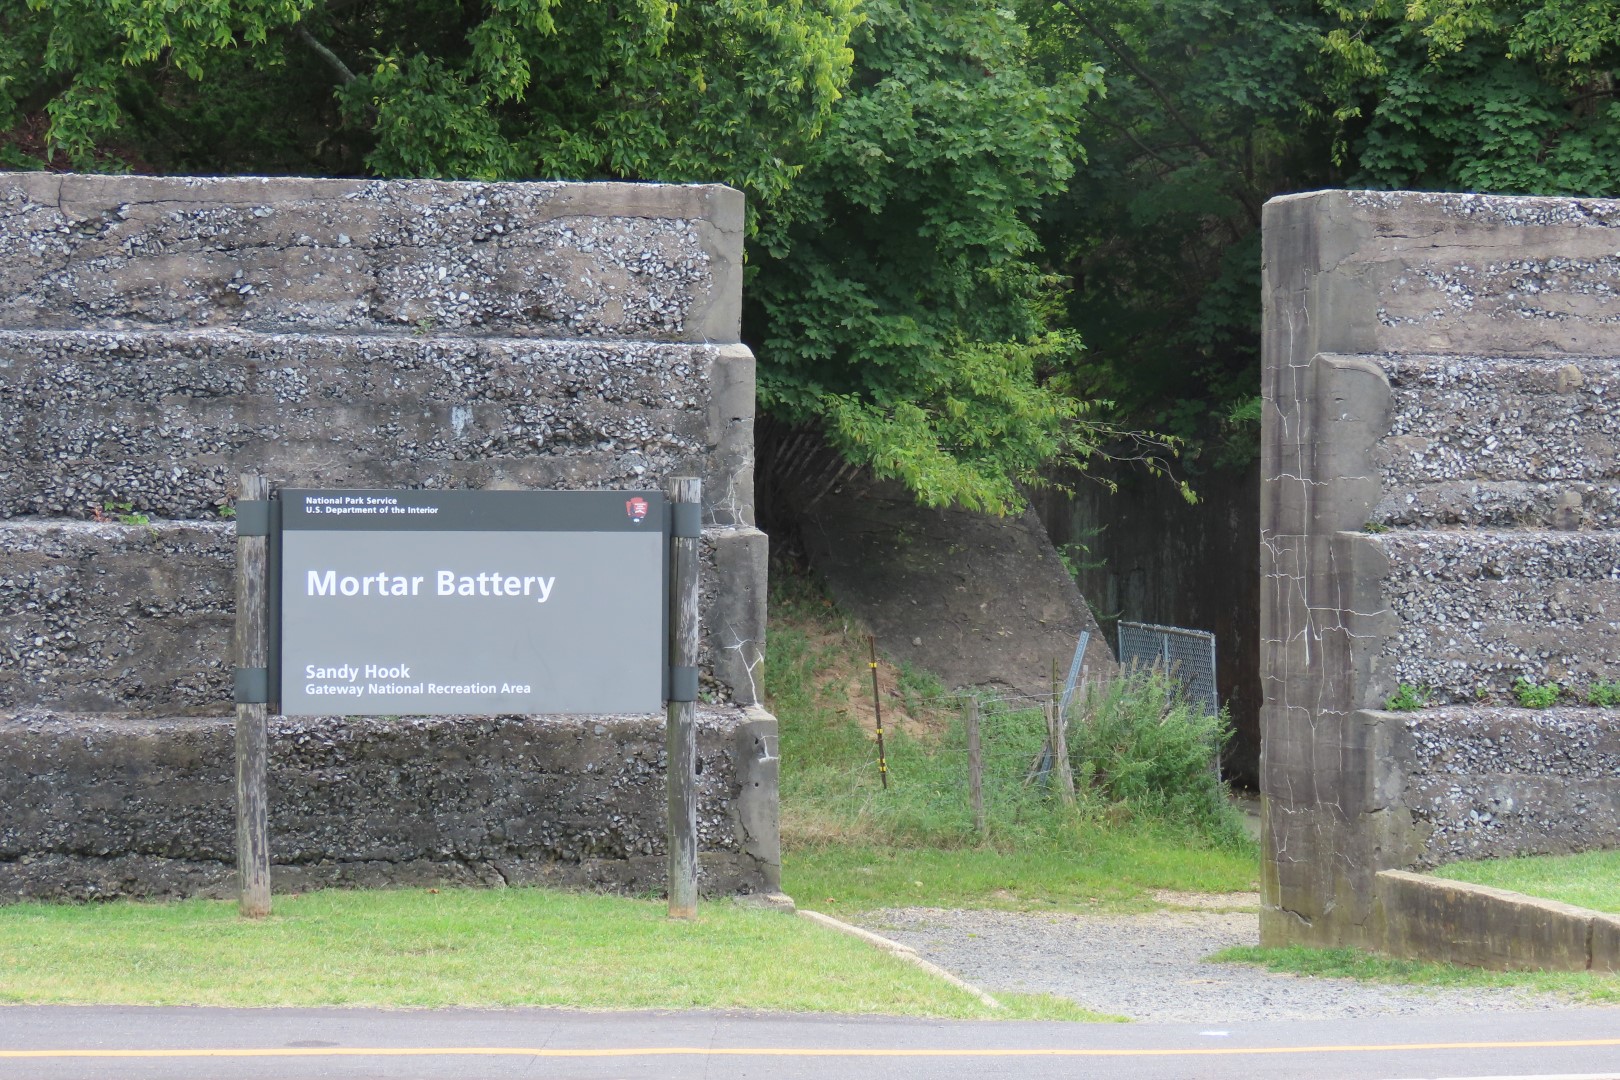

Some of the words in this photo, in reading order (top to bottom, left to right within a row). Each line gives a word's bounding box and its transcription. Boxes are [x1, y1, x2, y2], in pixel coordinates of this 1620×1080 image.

[306, 496, 342, 505] National
[345, 496, 364, 505] Park
[366, 496, 397, 505] Service
[306, 505, 323, 514] U.S.
[325, 506, 377, 516] Department
[379, 505, 389, 514] of
[391, 505, 405, 514] the
[407, 505, 438, 514] Interior
[306, 570, 424, 597] Mortar
[436, 570, 556, 603] Battery
[305, 663, 360, 682] Sandy
[364, 663, 411, 679] Hook
[305, 682, 365, 698] Gateway
[368, 682, 424, 695] National
[427, 682, 497, 695] Recreation
[500, 682, 532, 694] Area
